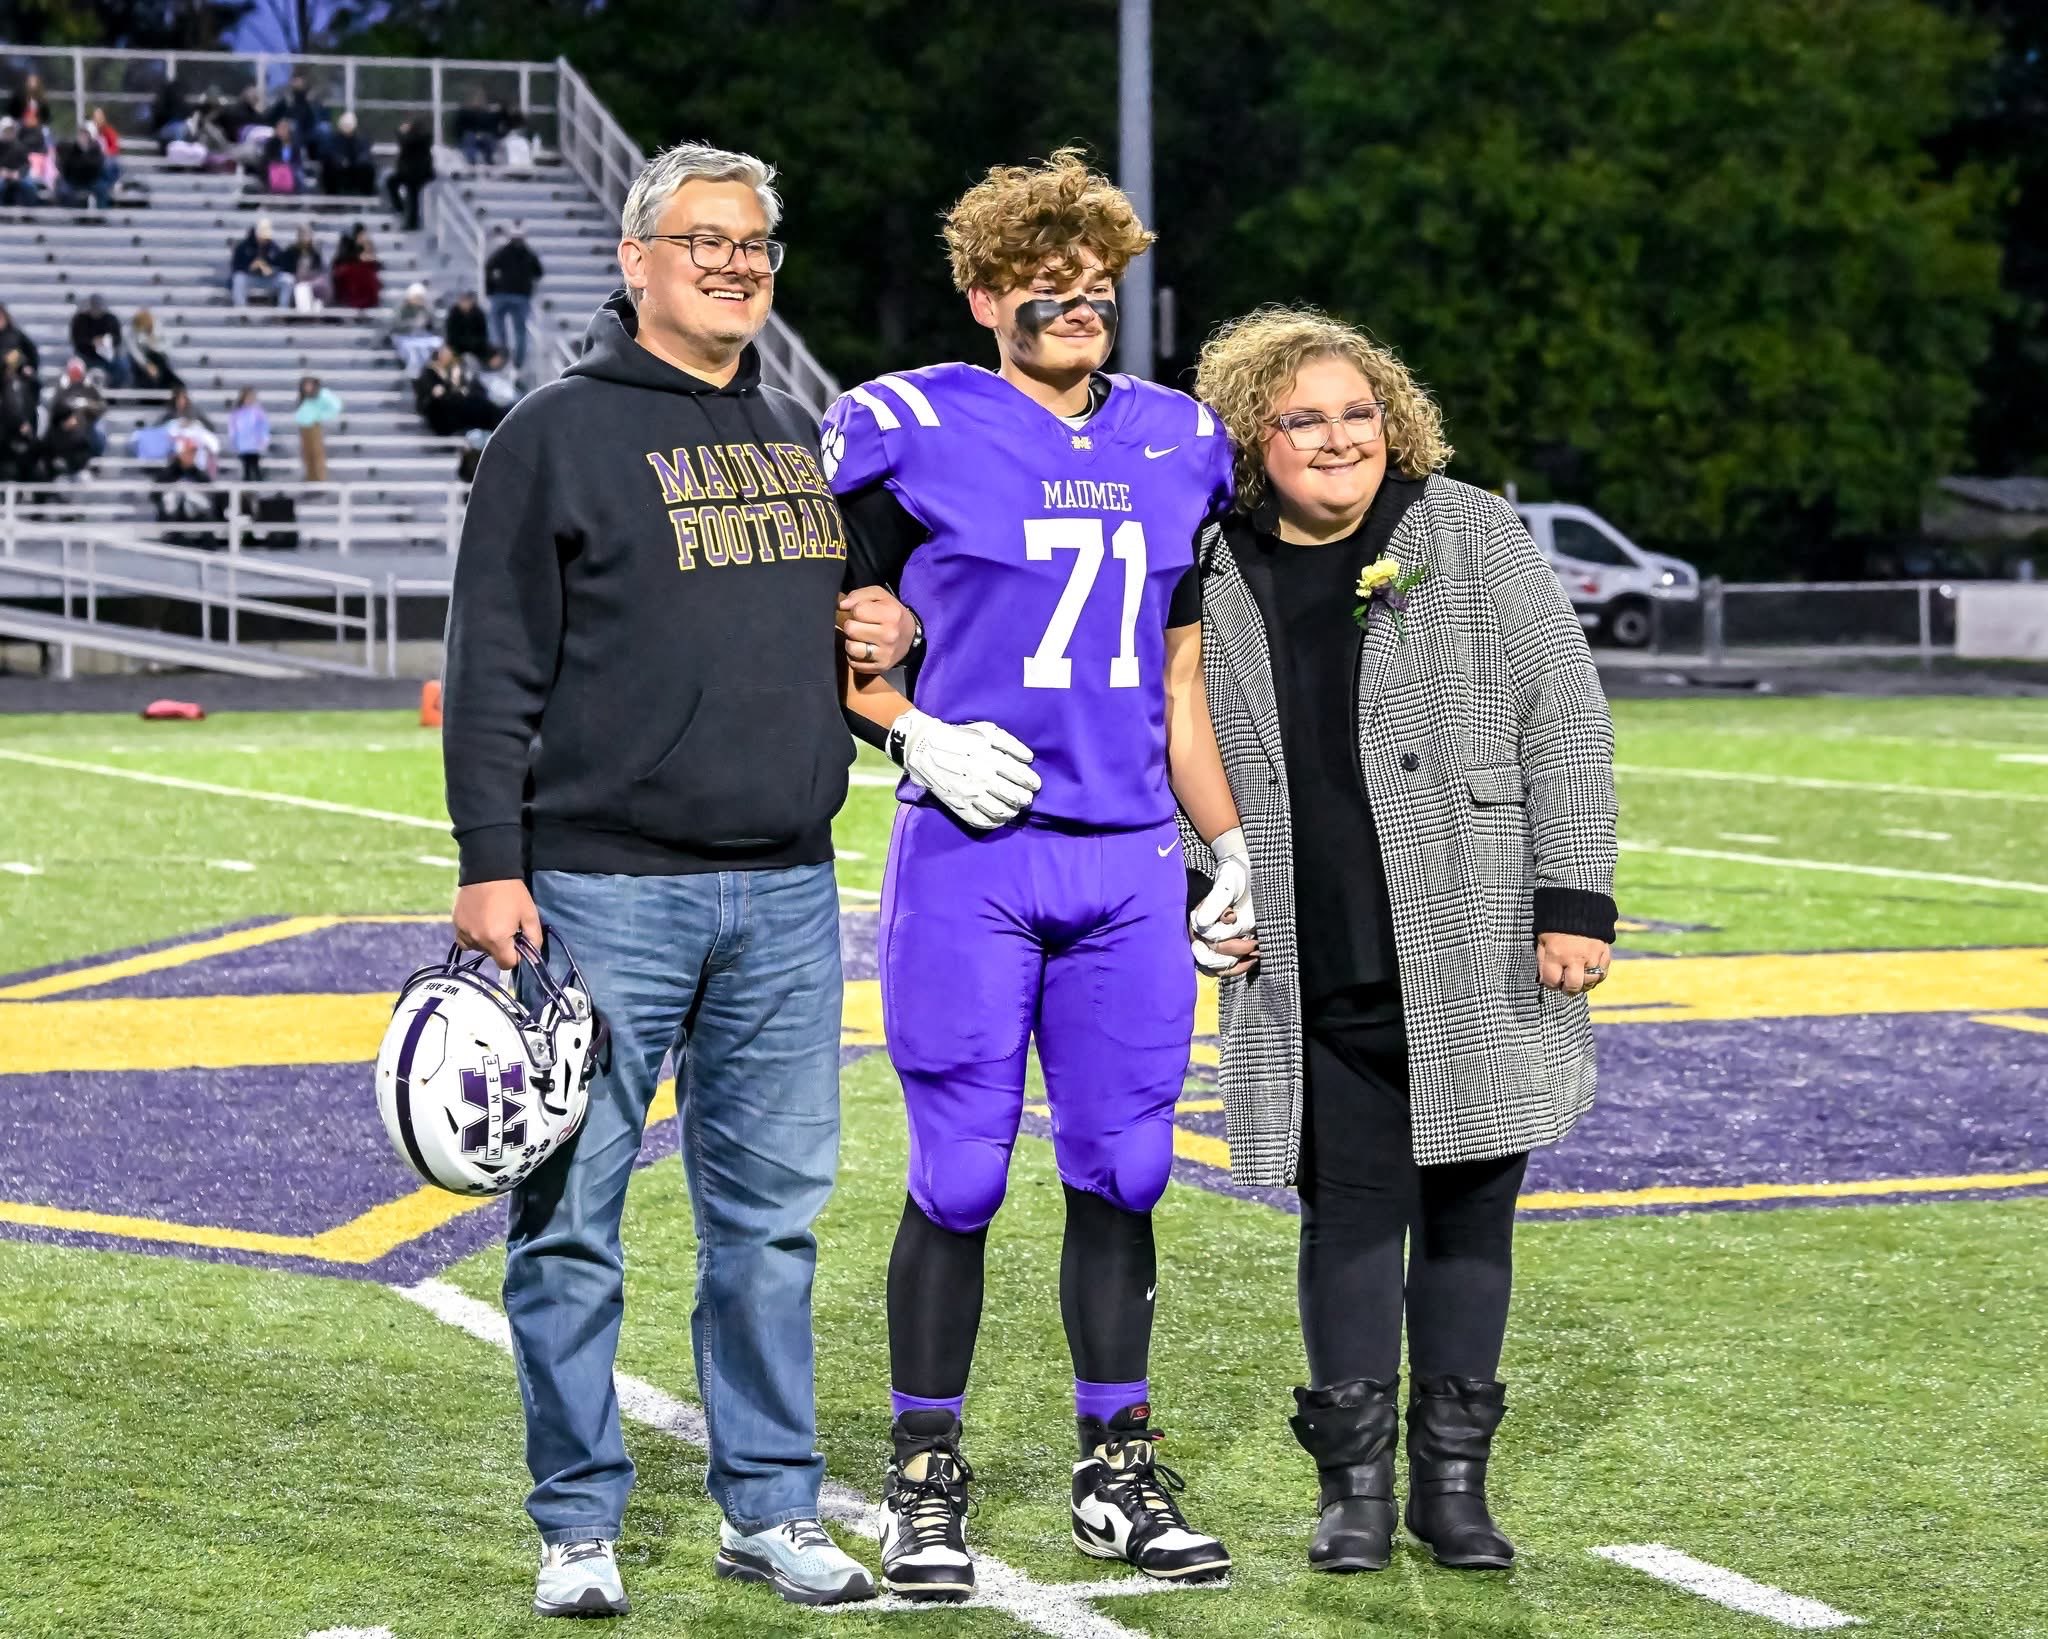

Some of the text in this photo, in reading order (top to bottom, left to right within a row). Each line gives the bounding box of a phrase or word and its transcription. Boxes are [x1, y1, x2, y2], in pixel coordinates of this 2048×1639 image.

[1041, 479, 1133, 512] MAUMEE
[1023, 518, 1147, 688] 71
[424, 982, 460, 996] WE ARE
[486, 1058, 502, 1157] MAUMEE
